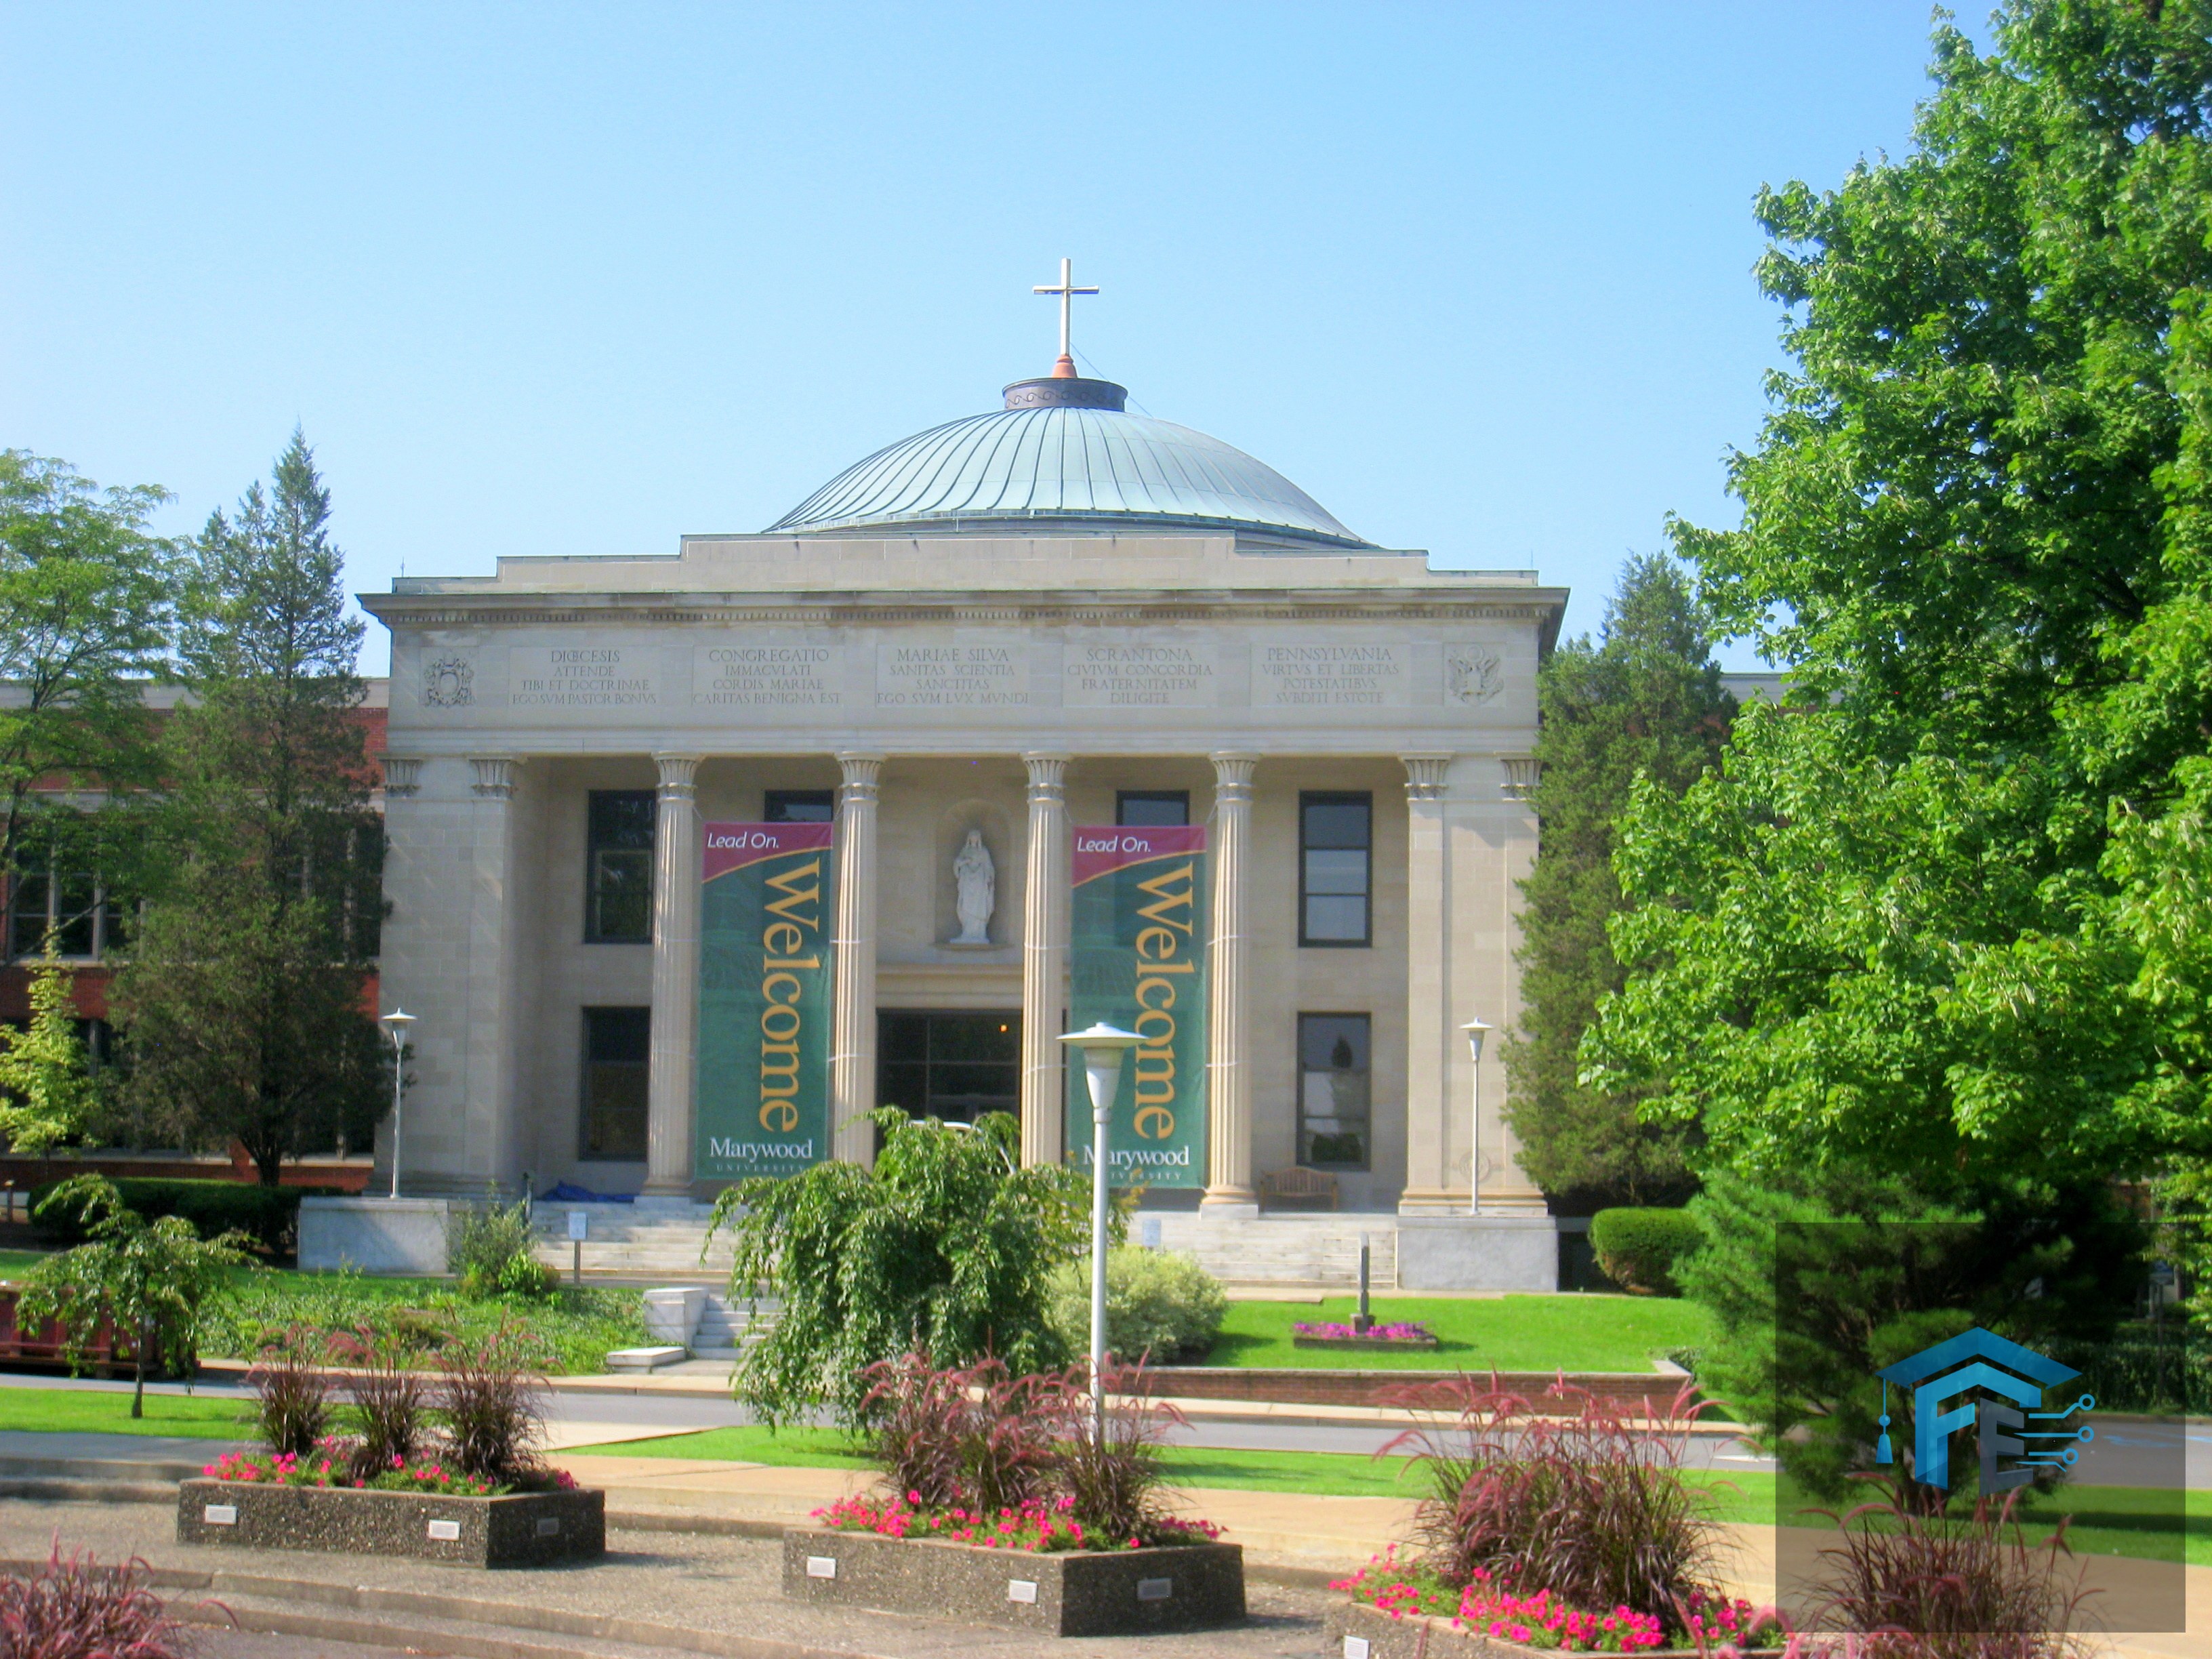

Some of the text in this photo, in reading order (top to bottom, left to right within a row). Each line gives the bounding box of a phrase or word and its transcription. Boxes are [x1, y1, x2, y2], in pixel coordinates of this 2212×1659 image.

[709, 649, 829, 662] CONGREGATIO
[897, 648, 1008, 661] MARIAE SILVA
[1086, 648, 1193, 661] SCRANTONA
[1268, 647, 1392, 661] PENNSYLVANIA
[554, 666, 615, 677] ATTENDE
[726, 665, 811, 676] IMMACVLATI
[890, 664, 1015, 676] SANITAS SCIENTIA
[1126, 664, 1213, 676] CONCORDIA
[1263, 664, 1399, 675] VIRTVS ET LIBERTAS
[521, 680, 649, 691] TIBI ET DOCTRINAE
[713, 678, 824, 690] CORDIS MARIAE
[916, 678, 989, 690] SANCTITAS
[1082, 678, 1197, 690] FRATERNITATEM
[512, 693, 657, 705] EGO SVM PASTOR BONVS
[693, 693, 841, 704] CARITAS BENIGNA EST
[912, 693, 940, 704] SVM
[946, 693, 974, 704] LVX
[1111, 693, 1170, 704] DILIGITE
[1335, 692, 1385, 703] ESTOTE
[708, 832, 779, 848] Lead On.
[1077, 836, 1151, 853] Lead On.
[758, 857, 821, 1132] Welcome
[1133, 861, 1195, 1140] Welcome
[710, 1136, 813, 1163] Marywood
[716, 1164, 804, 1172] UNIVERSITY
